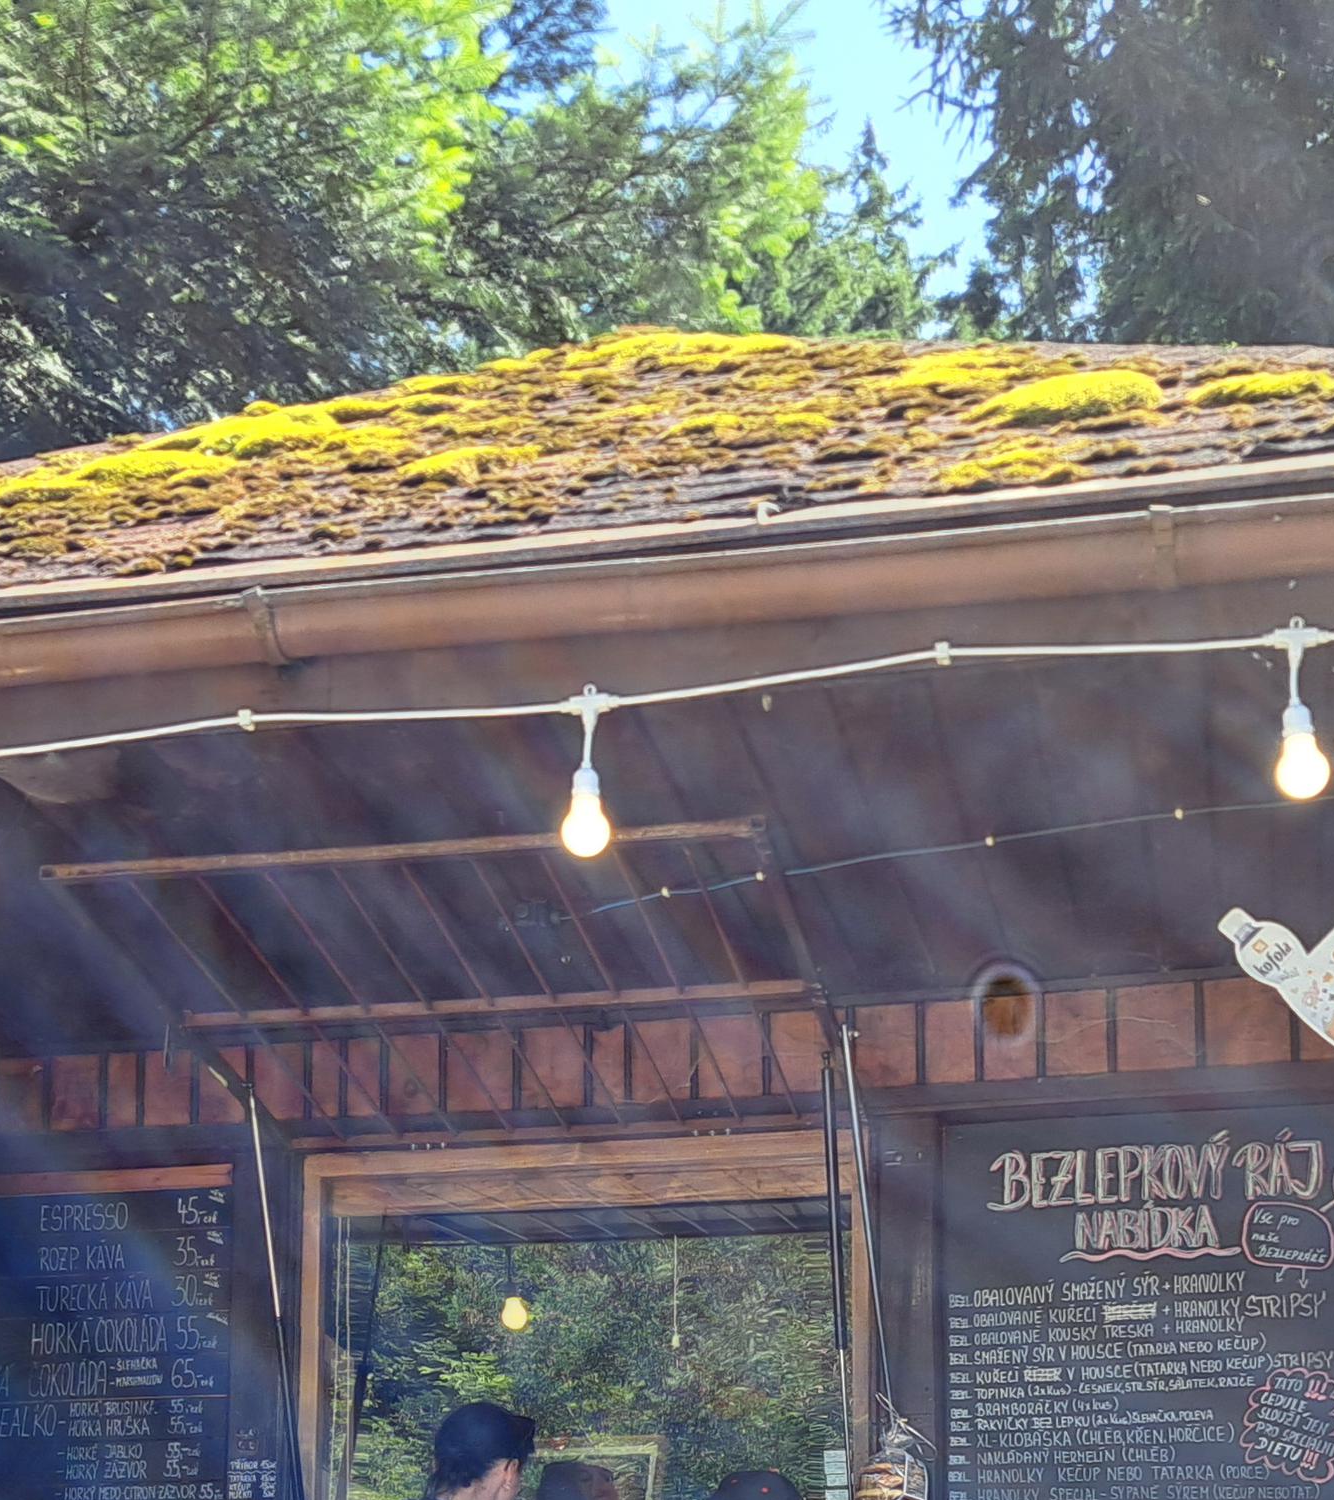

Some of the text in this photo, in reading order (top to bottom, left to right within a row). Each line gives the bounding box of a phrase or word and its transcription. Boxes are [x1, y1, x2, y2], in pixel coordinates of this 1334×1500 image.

[1254, 940, 1292, 978] kofola
[986, 1126, 1324, 1212] BEZLEPKOVÝ RÁJ
[40, 1202, 129, 1232] ESPRESSO
[1073, 1200, 1220, 1252] NABÍDKA
[86, 1239, 126, 1270] KÁVA
[36, 1274, 154, 1312] TURECKÁ KÁVA
[973, 1270, 1246, 1309] OBALOVANÝ SMAŽENÝ SÝR HRANOLKY
[973, 1290, 1326, 1329] OBALOVANÉ KUŘECÍ HRANOLKY STRIPSY
[30, 1314, 168, 1356] HORKÁ ČOKOLÁDA
[974, 1315, 1246, 1346] OBALOVANÉ KOUSKY TRESKA HRANOLKY
[973, 1341, 1125, 1366] SMAŽENÝ SÝR V HOUSCE
[1273, 1350, 1334, 1371] STRIPSY
[973, 1385, 1026, 1401] TOPINKA
[1274, 1377, 1304, 1392] TATO
[974, 1397, 1069, 1418] BRAMBORÁČKY
[106, 1416, 151, 1437] HRUŠKA
[104, 1442, 144, 1460] JABLKO
[976, 1446, 1116, 1466] NAKLÁDANÝ HERMELÍN
[1255, 1436, 1303, 1462] DIETU
[976, 1462, 1215, 1484] HRANOLKY KEČUP NEBO TATARKA
